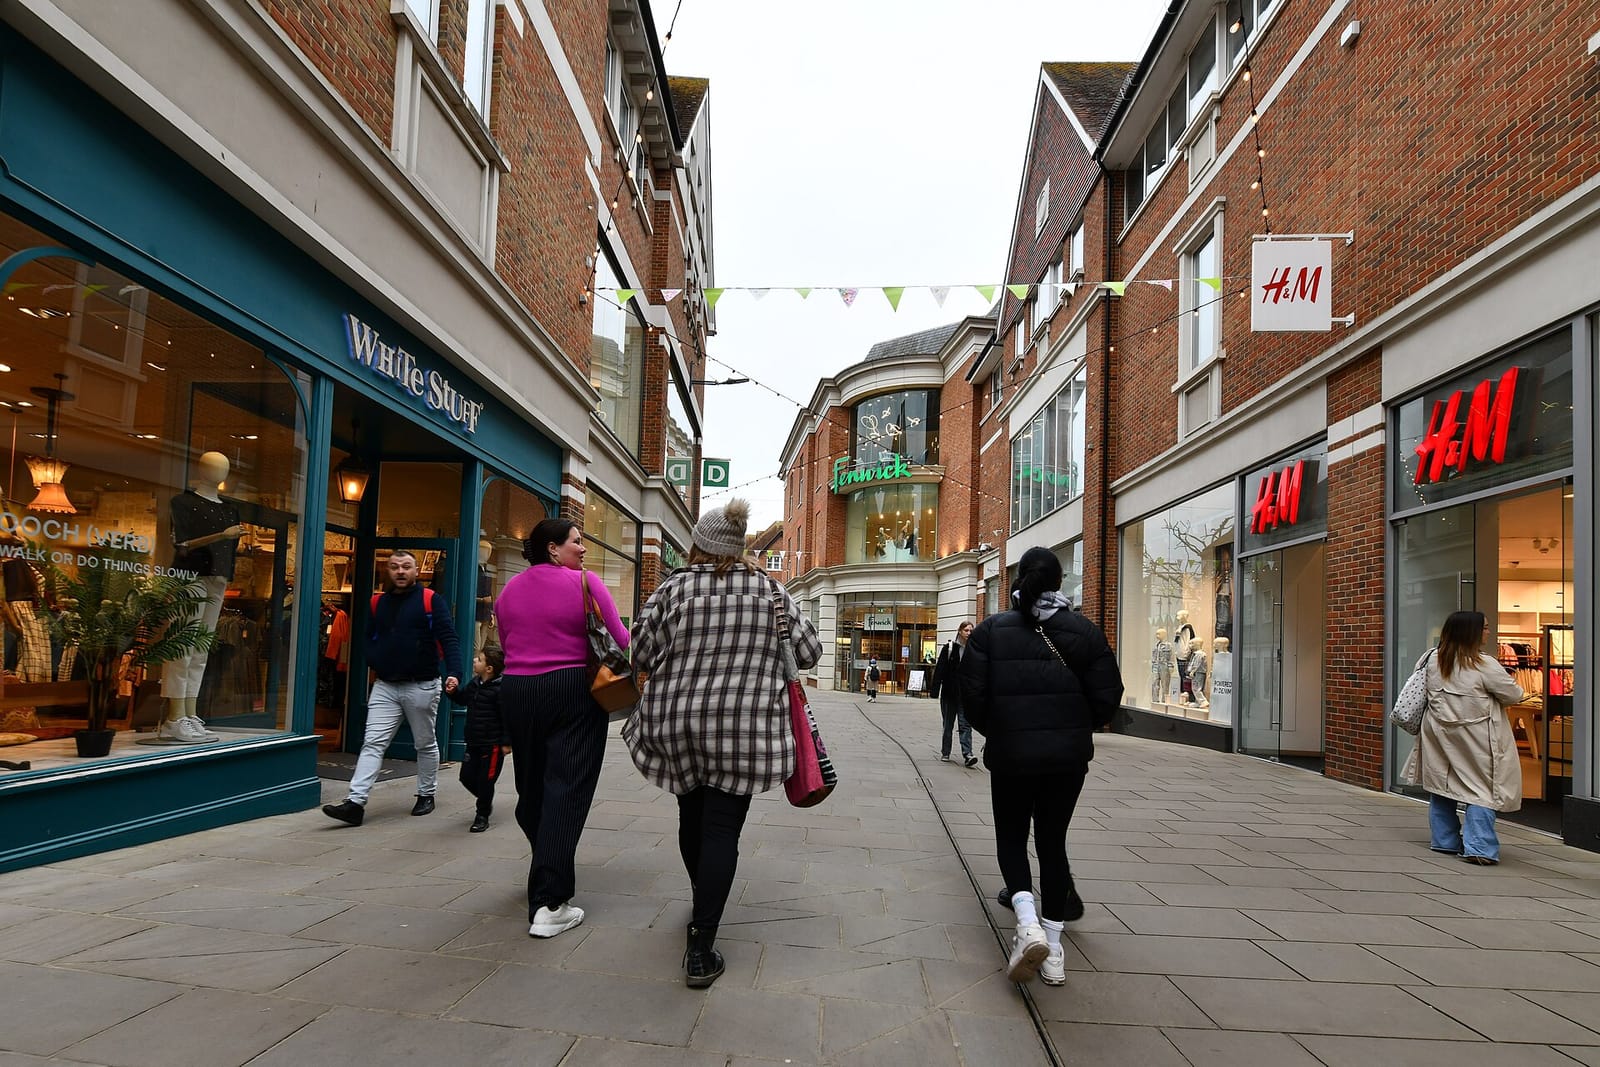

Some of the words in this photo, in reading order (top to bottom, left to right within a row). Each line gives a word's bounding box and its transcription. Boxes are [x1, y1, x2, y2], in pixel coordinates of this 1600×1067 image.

[1261, 265, 1323, 305] H&M
[1414, 366, 1519, 485] H&M
[707, 465, 726, 483] D
[832, 452, 912, 494] Fenwick
[1250, 459, 1304, 534] H&M
[0, 544, 46, 562] WALK
[51, 551, 73, 565] OR
[77, 555, 99, 568] DO
[102, 558, 150, 576] THINGS
[153, 565, 199, 581] SLOWLY
